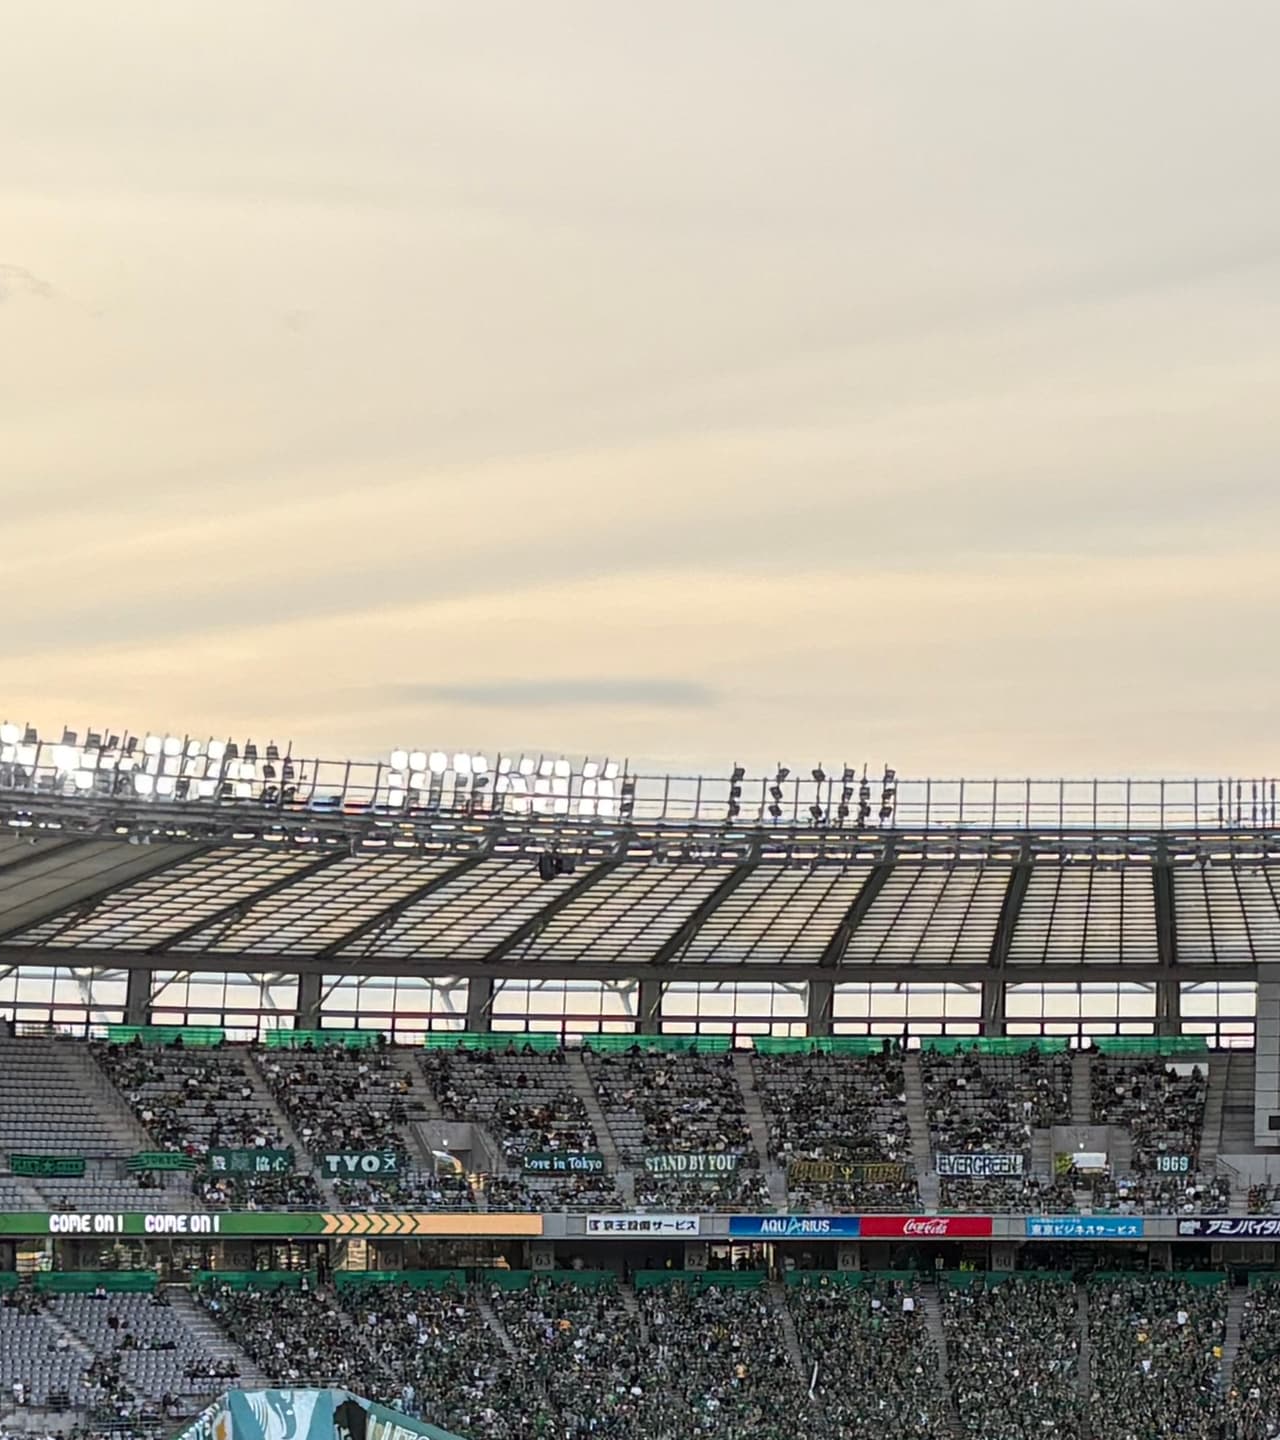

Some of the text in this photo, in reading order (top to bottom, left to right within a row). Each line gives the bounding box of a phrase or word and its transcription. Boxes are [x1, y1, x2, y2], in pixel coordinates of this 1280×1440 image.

[325, 1154, 380, 1173] TYO
[524, 1156, 602, 1172] Love in Tokyo
[645, 1155, 737, 1171] STAND BY YOU
[939, 1155, 1021, 1173] EVERGREEN
[49, 1214, 91, 1232] COME
[145, 1215, 187, 1232] COME
[761, 1216, 830, 1234] AQUARIUS
